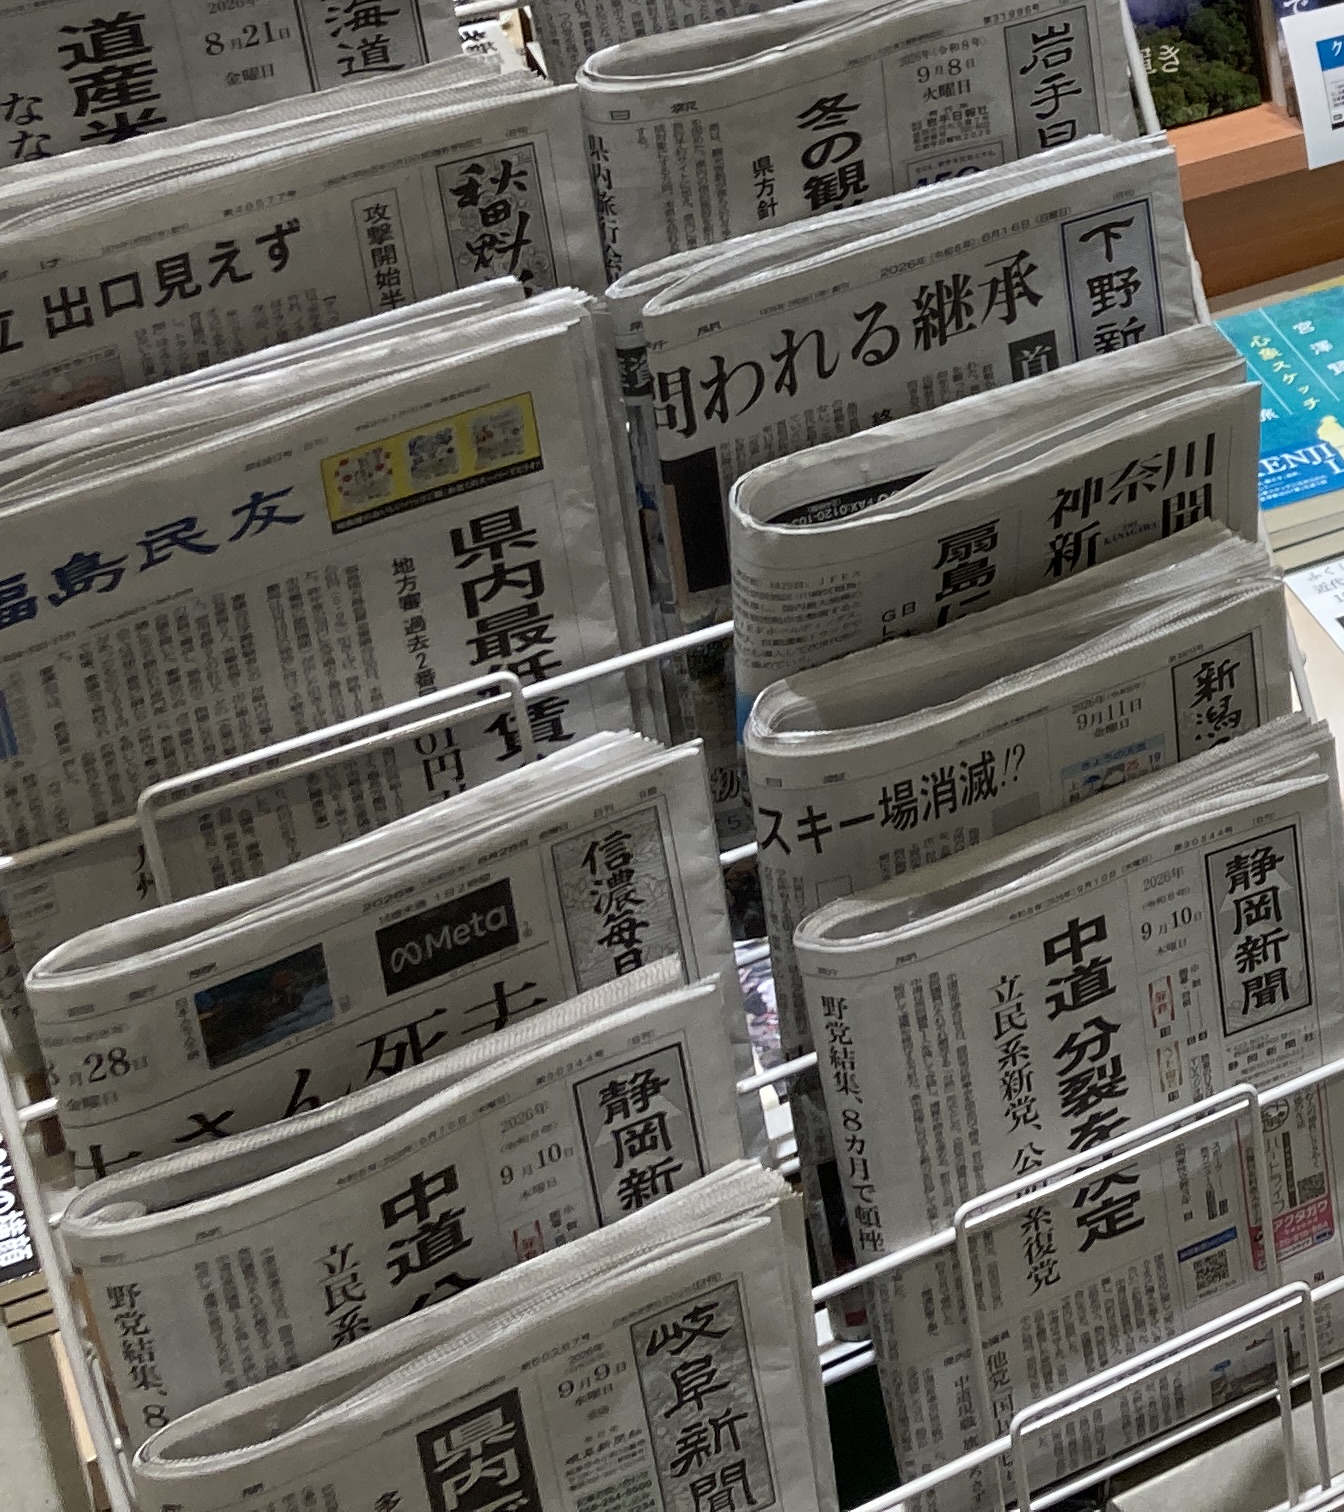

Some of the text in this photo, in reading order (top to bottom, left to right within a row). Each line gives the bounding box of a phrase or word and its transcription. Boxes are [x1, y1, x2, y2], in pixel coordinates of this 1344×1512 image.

[204, 20, 292, 57] 8月21日
[916, 55, 977, 85] 9月8日
[1019, 22, 1084, 148] 岩手日
[752, 158, 779, 221] 県方針
[44, 217, 302, 340] 出口見えず
[1077, 214, 1148, 356] 下野新
[651, 249, 1045, 437] 問われる継承
[1052, 432, 1219, 528] 神奈川
[1076, 697, 1144, 733] 9月11日
[1192, 657, 1242, 744] 新潟
[422, 907, 511, 955] Meta
[582, 826, 655, 975] 信濃毎日
[1140, 906, 1202, 943] 9月10日
[1222, 845, 1296, 1018] 静岡新聞
[1042, 914, 1117, 1022] 中道
[600, 1068, 685, 1214] 静岡新
[990, 974, 1060, 1296] 立民系新党、公系復党
[645, 1301, 760, 1512] 岐阜新聞
